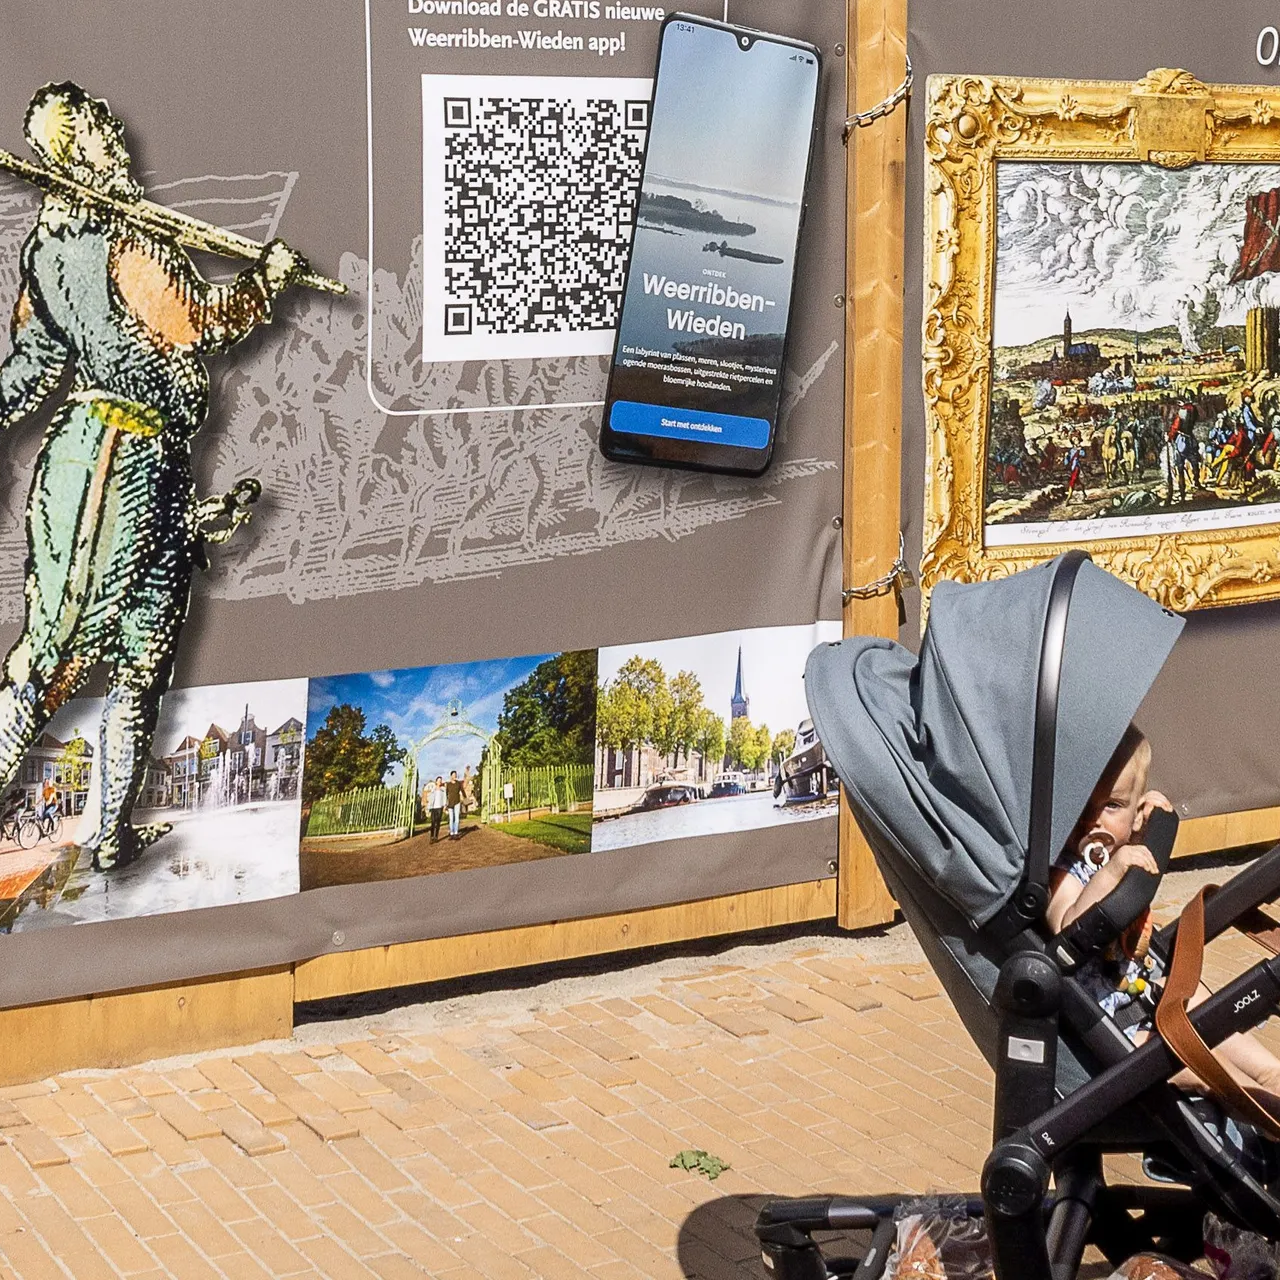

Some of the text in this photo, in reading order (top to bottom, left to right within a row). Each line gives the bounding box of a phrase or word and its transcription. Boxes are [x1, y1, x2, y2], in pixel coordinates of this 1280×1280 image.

[533, 0, 600, 19] GRATIS
[605, 0, 665, 21] nieuwe
[675, 23, 696, 34] 13:41
[407, 27, 626, 56] Weerribben-Wieden app!
[643, 273, 776, 312] Weerribben-
[667, 308, 746, 340] Wieden
[660, 418, 676, 428] Start
[676, 421, 690, 429] met
[1233, 989, 1261, 1013] JOOLZ
[1041, 1131, 1055, 1146] DAY
